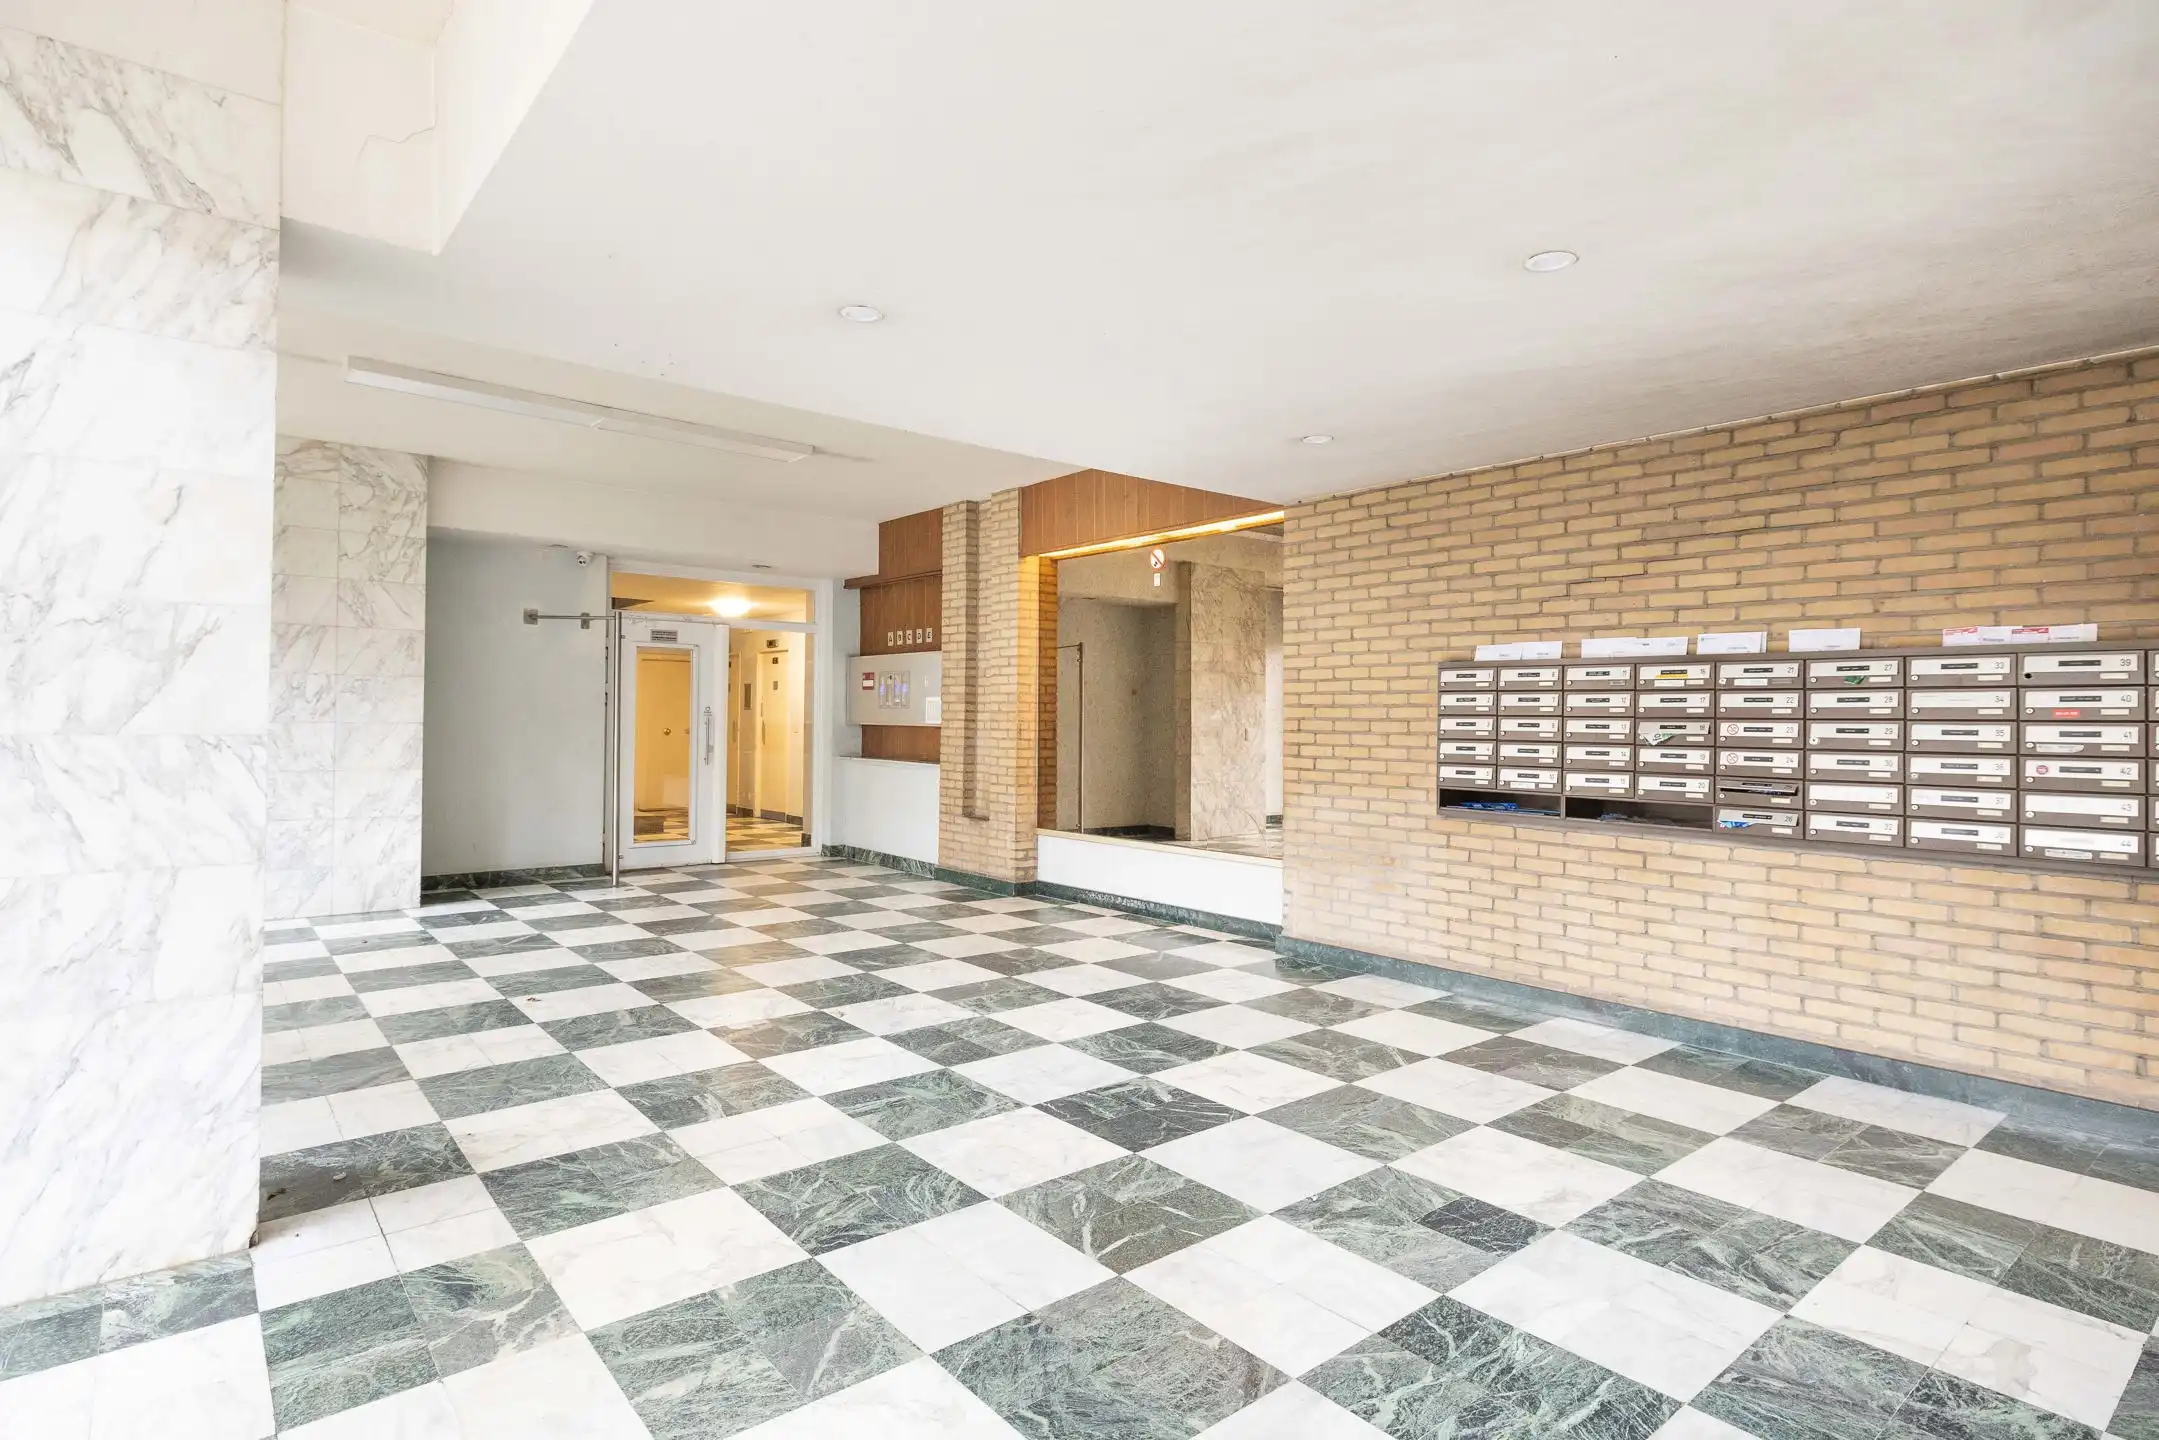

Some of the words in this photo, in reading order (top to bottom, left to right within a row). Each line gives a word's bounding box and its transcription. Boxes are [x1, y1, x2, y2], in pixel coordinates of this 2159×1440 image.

[2120, 658, 2131, 667] 39
[2120, 694, 2131, 703] 40
[2120, 767, 2131, 775] 42
